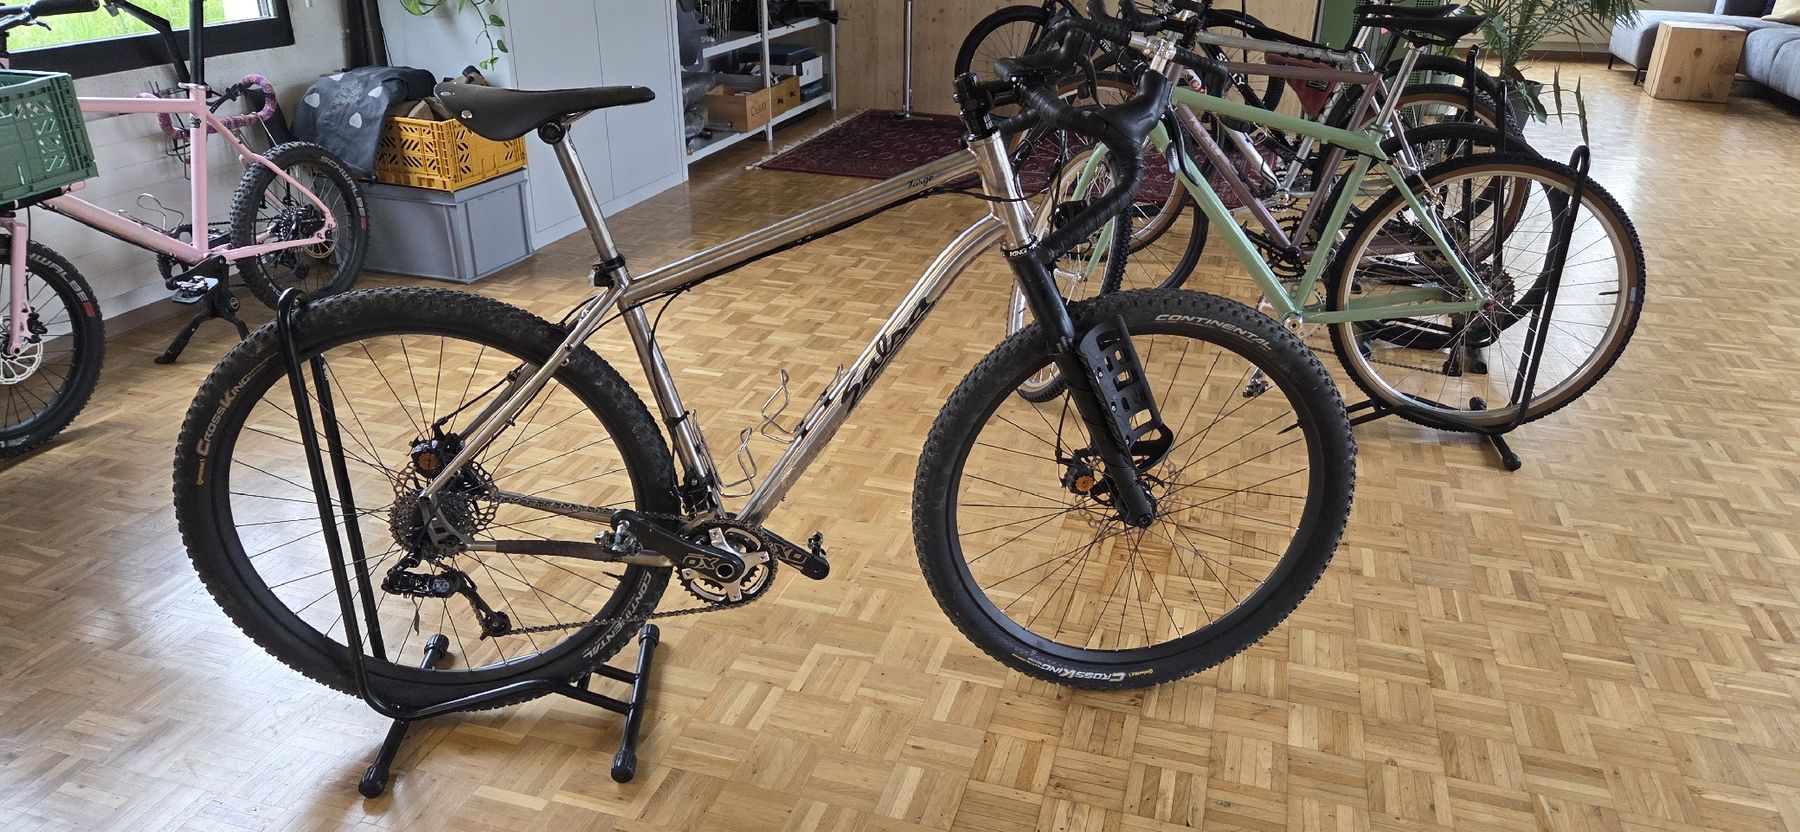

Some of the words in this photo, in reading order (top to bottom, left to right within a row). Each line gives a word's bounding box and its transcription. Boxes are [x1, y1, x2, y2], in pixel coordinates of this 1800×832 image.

[1216, 52, 1246, 86] SLY
[320, 156, 366, 216] SCHWALBE
[1009, 247, 1028, 257] KING
[1154, 314, 1273, 350] CONTINENTAL
[841, 296, 938, 416] Salsa
